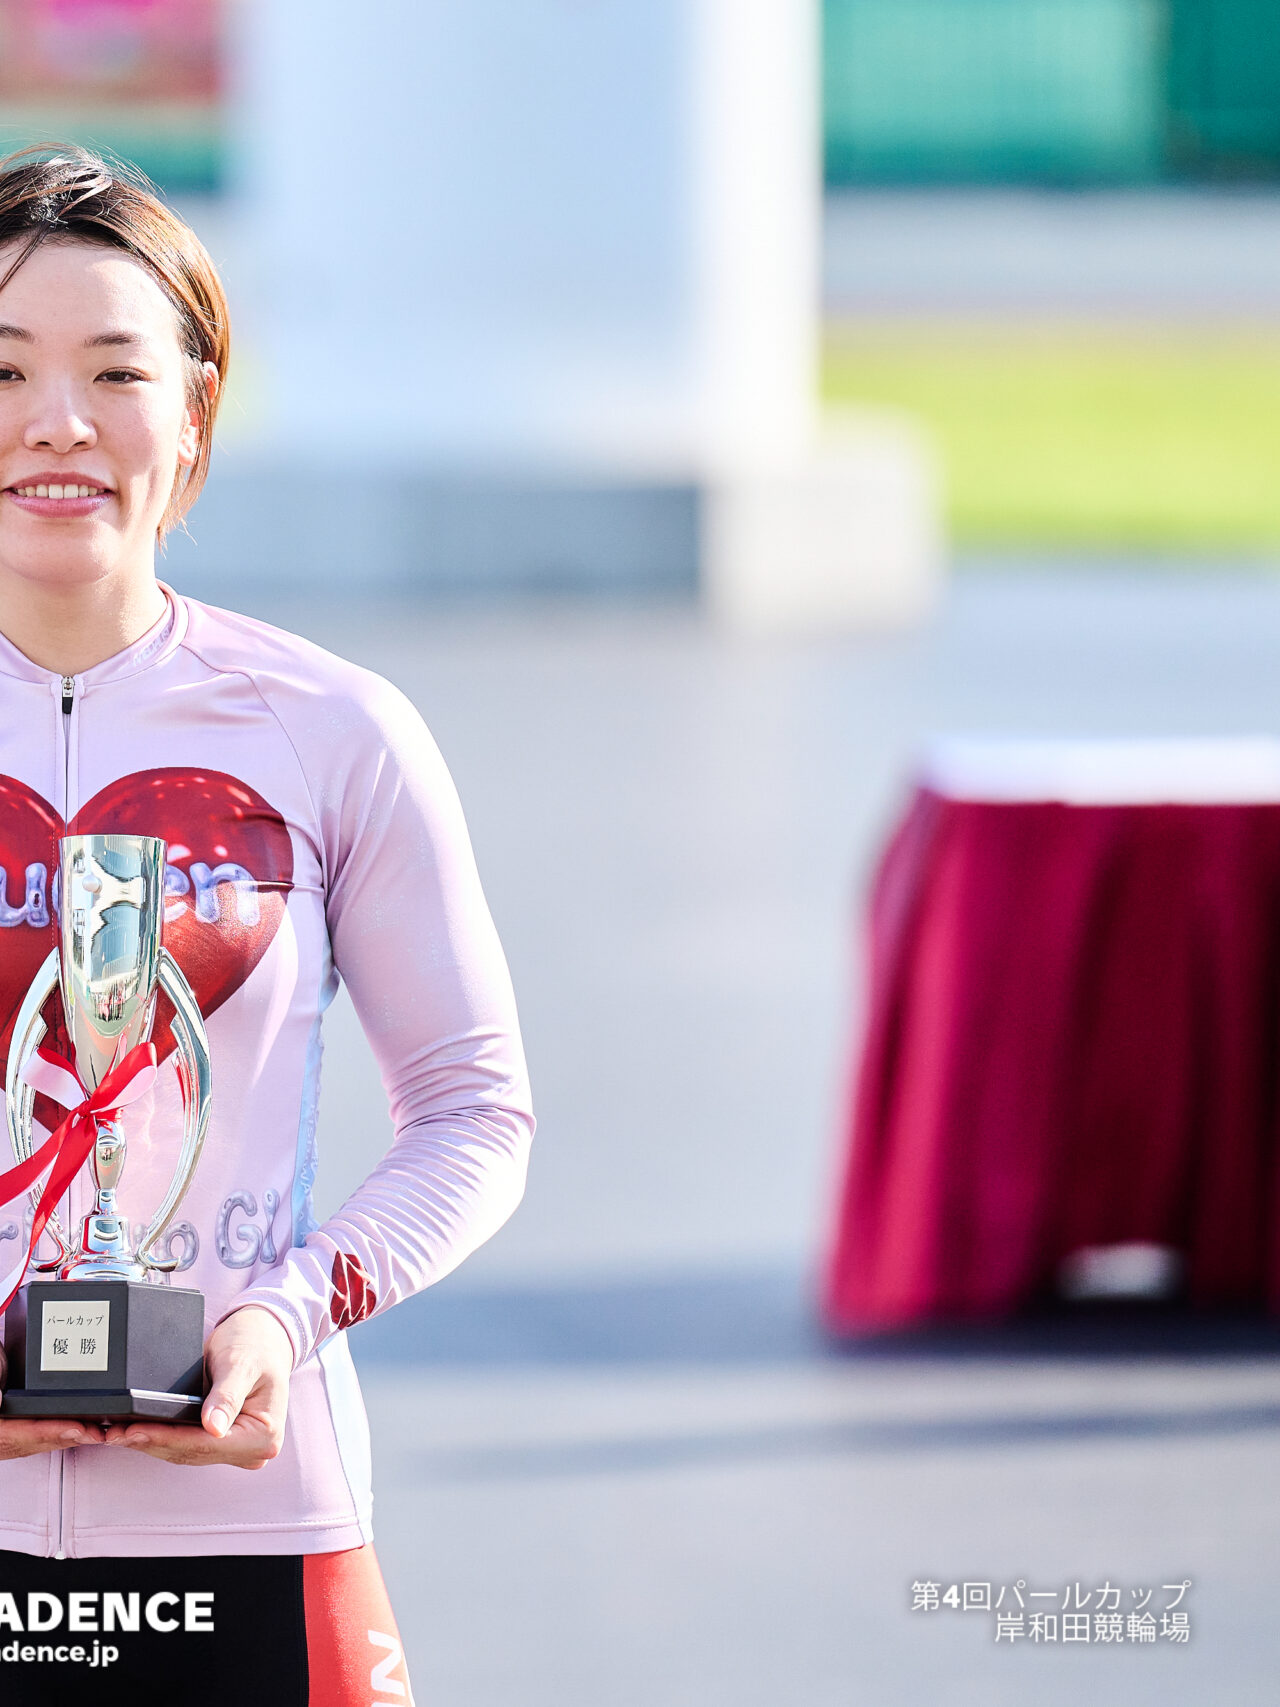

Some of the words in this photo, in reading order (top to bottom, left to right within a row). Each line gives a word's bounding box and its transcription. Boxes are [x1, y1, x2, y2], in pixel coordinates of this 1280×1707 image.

[46, 1314, 105, 1326] パールカップ
[53, 1337, 97, 1355] 優勝
